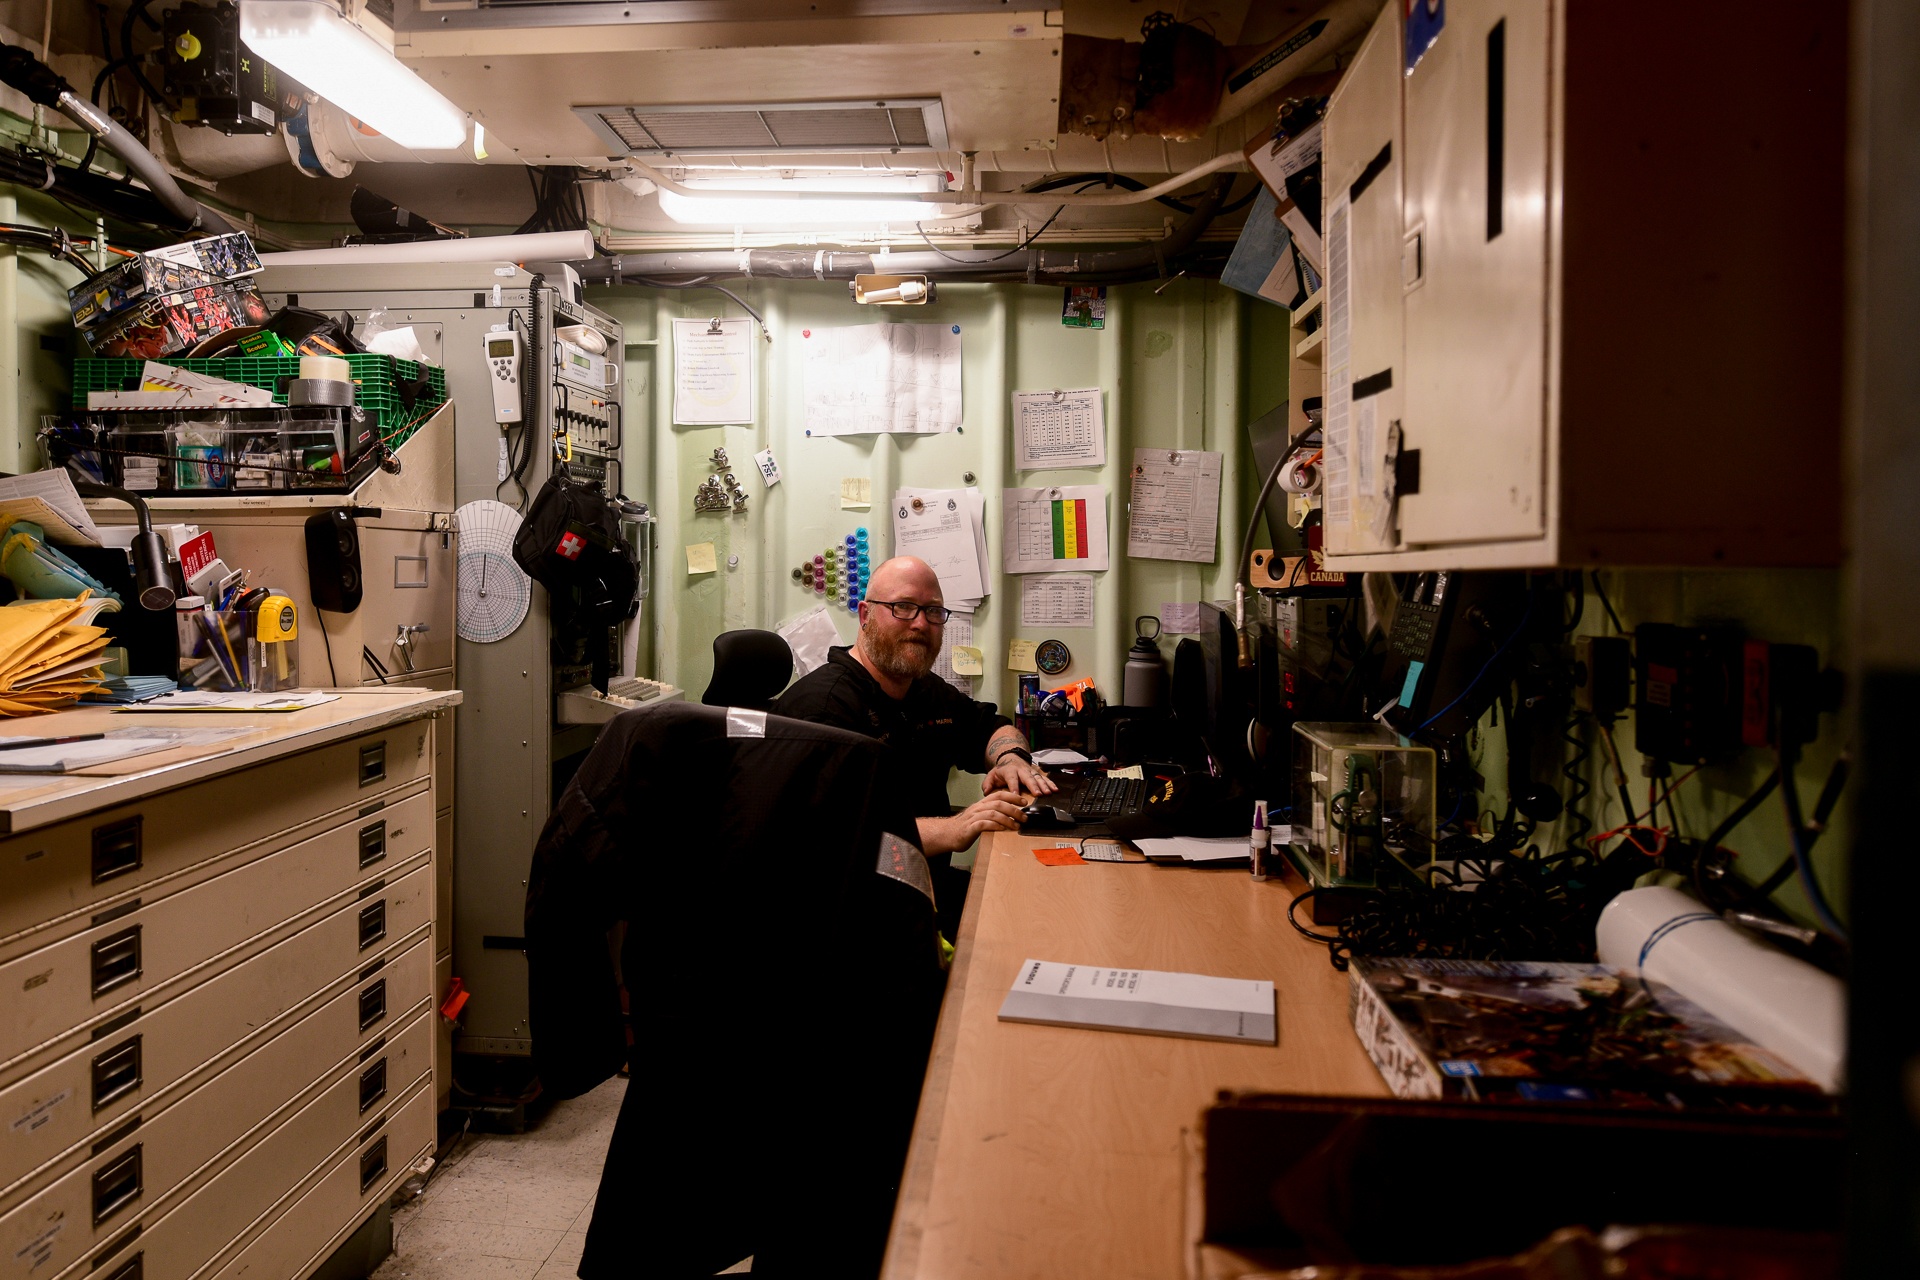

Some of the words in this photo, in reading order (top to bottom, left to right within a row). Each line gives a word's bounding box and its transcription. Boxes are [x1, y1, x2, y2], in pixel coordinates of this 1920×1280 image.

[241, 334, 262, 345] Scotch
[246, 342, 268, 353] Scotch
[762, 464, 774, 478] FSE
[1310, 572, 1344, 582] CANADA
